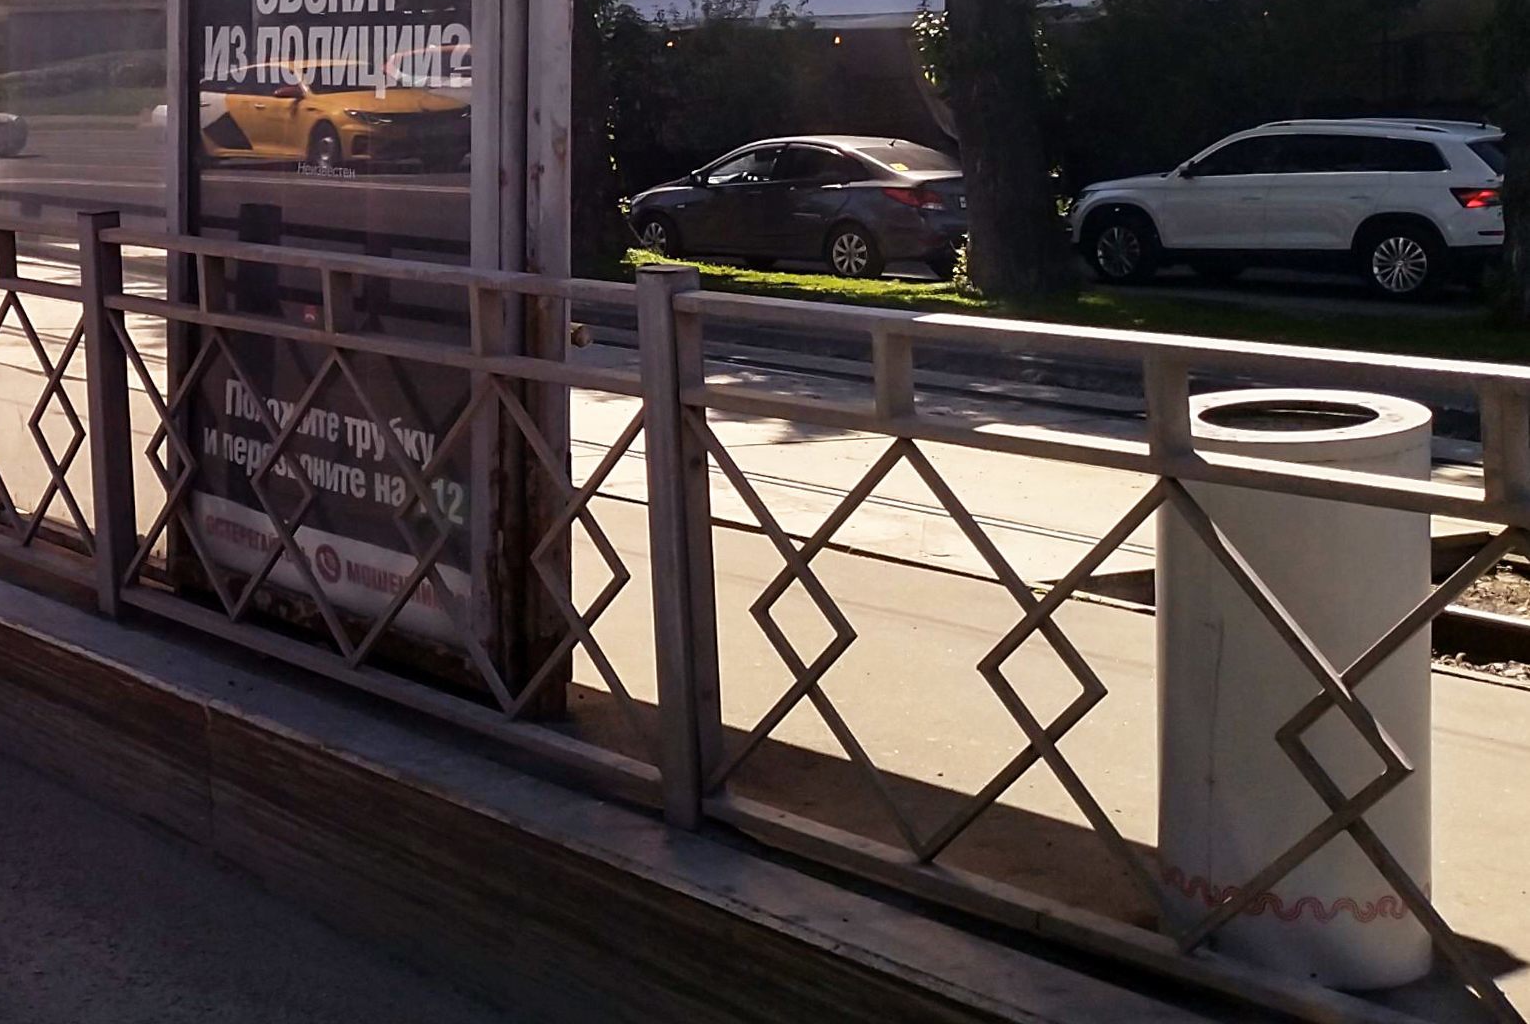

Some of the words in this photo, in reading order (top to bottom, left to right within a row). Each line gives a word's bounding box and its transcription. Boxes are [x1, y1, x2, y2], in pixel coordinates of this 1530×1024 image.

[204, 25, 248, 85] ИЗ
[256, 23, 471, 99] ПОЛИЦИИ?
[225, 378, 340, 442] Поожите
[203, 427, 218, 456] и
[222, 432, 368, 499] перзоните
[374, 472, 406, 507] на
[419, 478, 464, 525] 12
